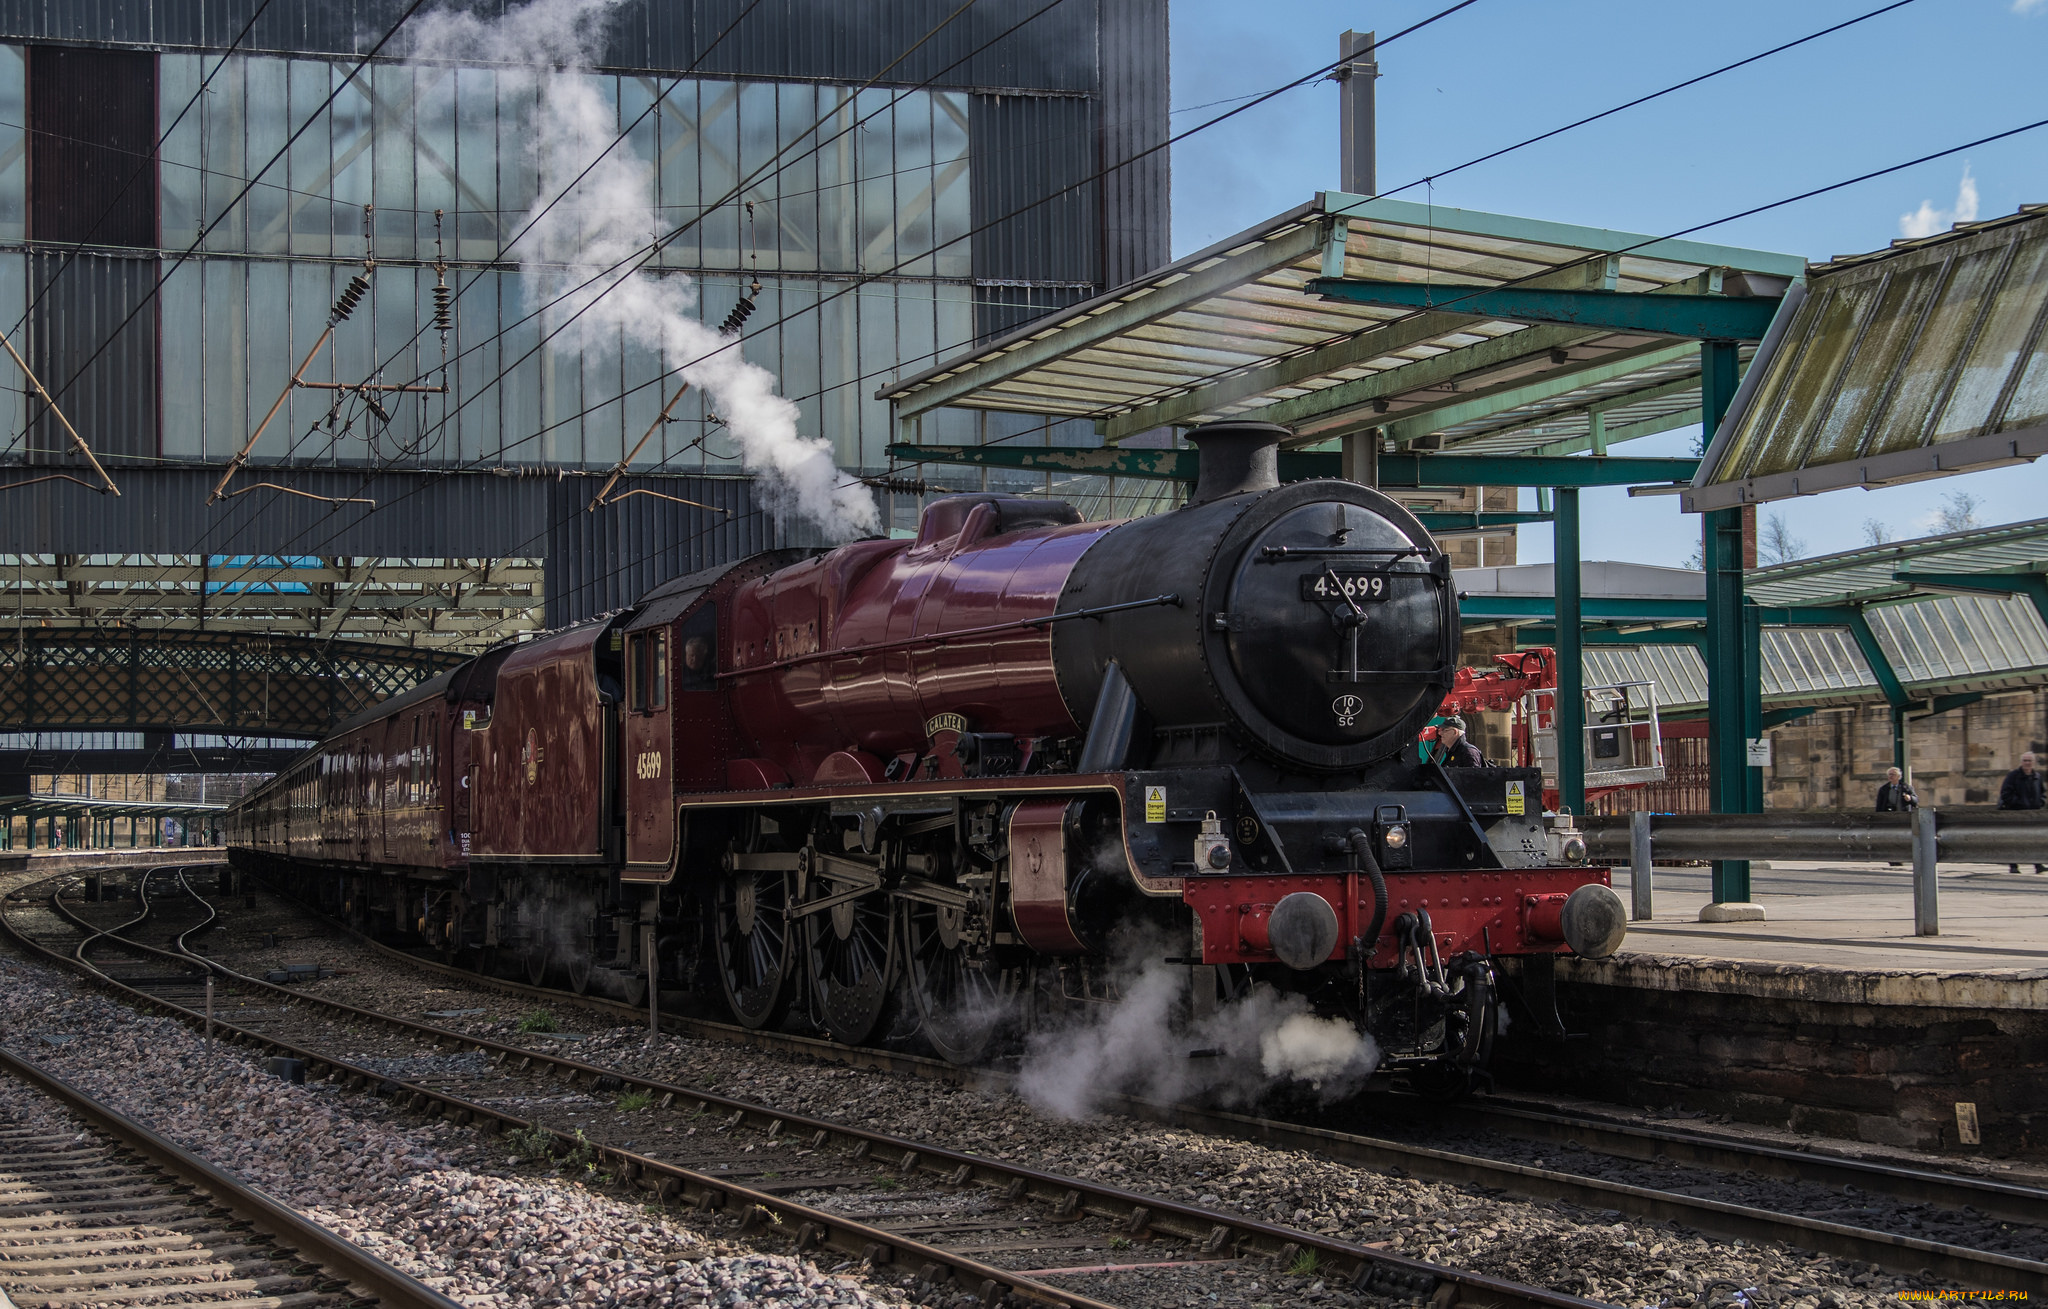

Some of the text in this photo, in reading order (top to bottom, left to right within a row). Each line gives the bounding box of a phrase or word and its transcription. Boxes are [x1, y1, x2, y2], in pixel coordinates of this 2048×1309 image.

[1343, 697, 1354, 707] 10
[1344, 707, 1351, 715] A
[1338, 716, 1354, 727] SC
[636, 751, 662, 780] 45699
